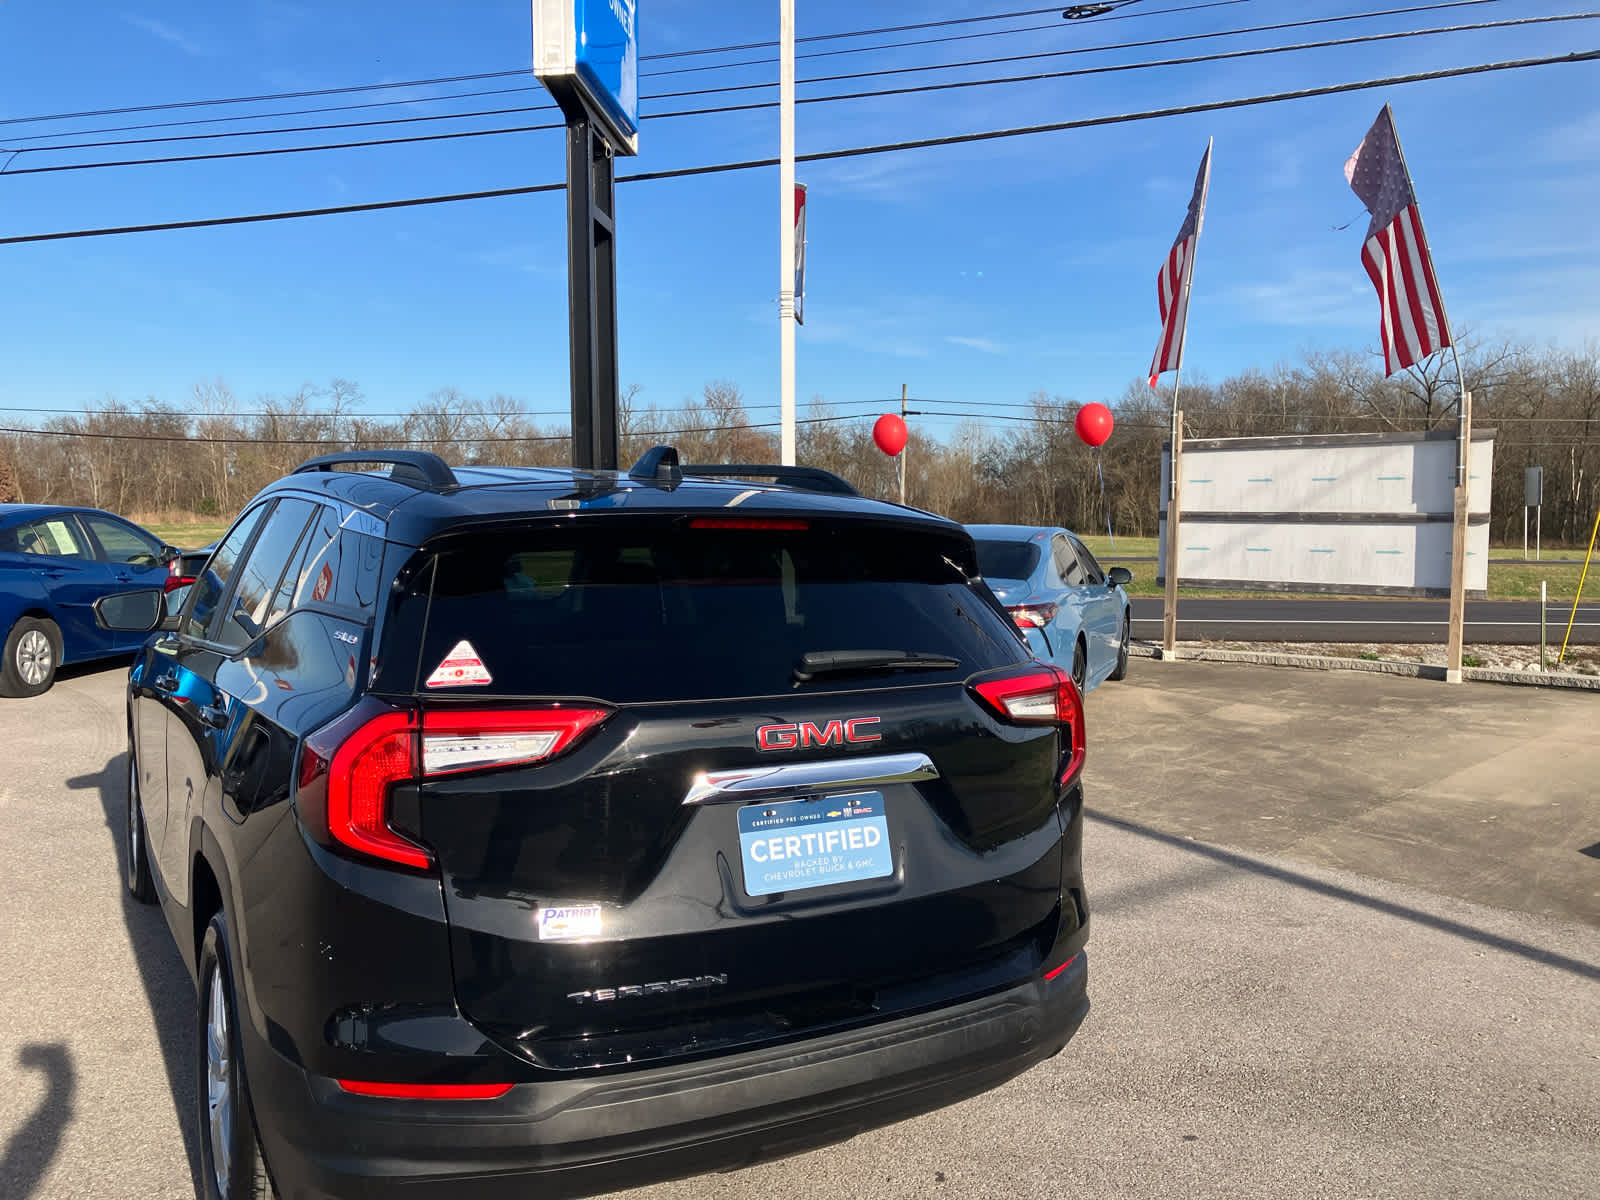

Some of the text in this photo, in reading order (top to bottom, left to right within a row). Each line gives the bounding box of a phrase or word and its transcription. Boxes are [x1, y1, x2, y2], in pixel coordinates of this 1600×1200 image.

[757, 716, 882, 752] GMC
[752, 817, 784, 827] CERTIFIED
[751, 826, 880, 862] CERTIFIED
[764, 866, 817, 881] CHEVROLET
[819, 863, 845, 874] BUICK
[855, 857, 874, 868] GMC
[794, 855, 843, 869] BACKED BY
[566, 973, 727, 1004] TERRAIN
